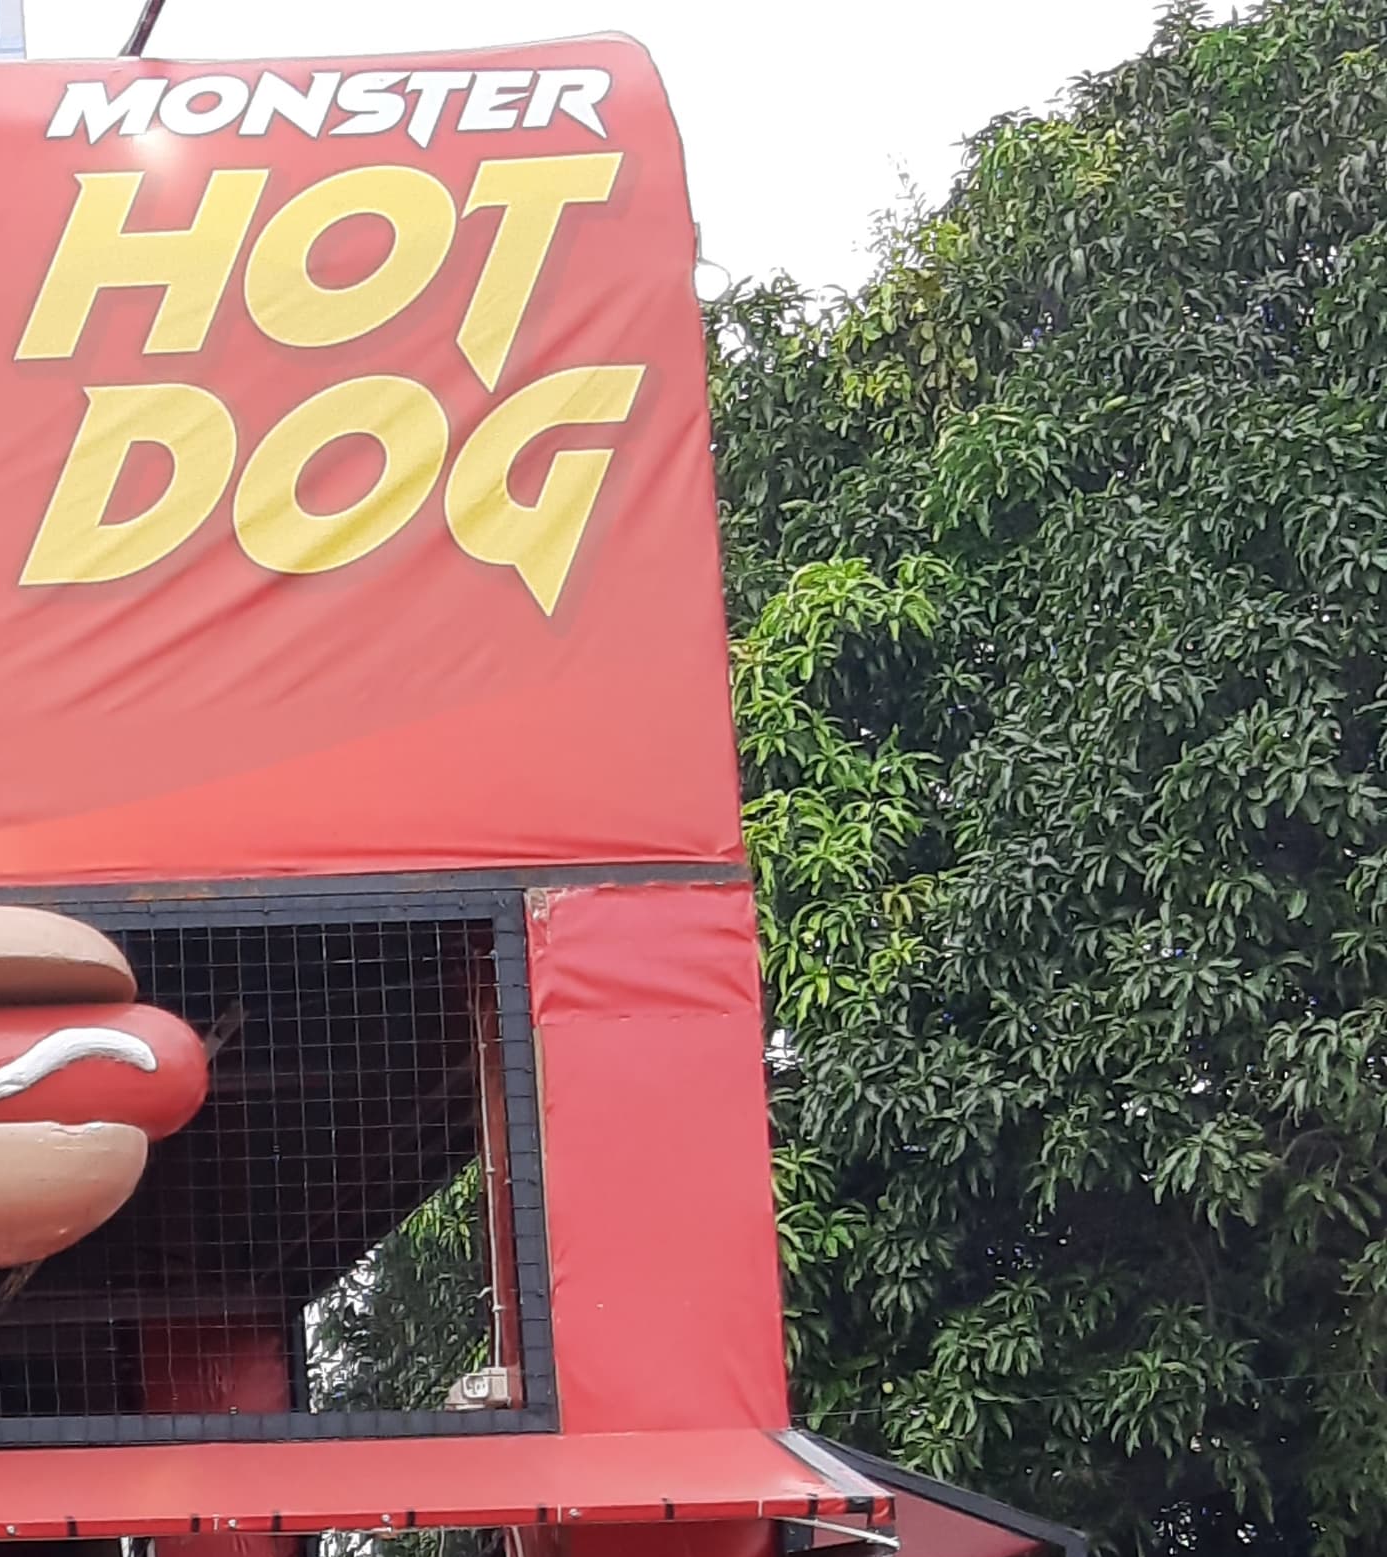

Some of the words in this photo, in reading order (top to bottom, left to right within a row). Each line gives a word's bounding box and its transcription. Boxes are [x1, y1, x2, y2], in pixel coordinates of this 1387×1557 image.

[45, 69, 612, 149] MONSTER
[13, 151, 624, 394] HOT
[17, 363, 647, 616] DOG
